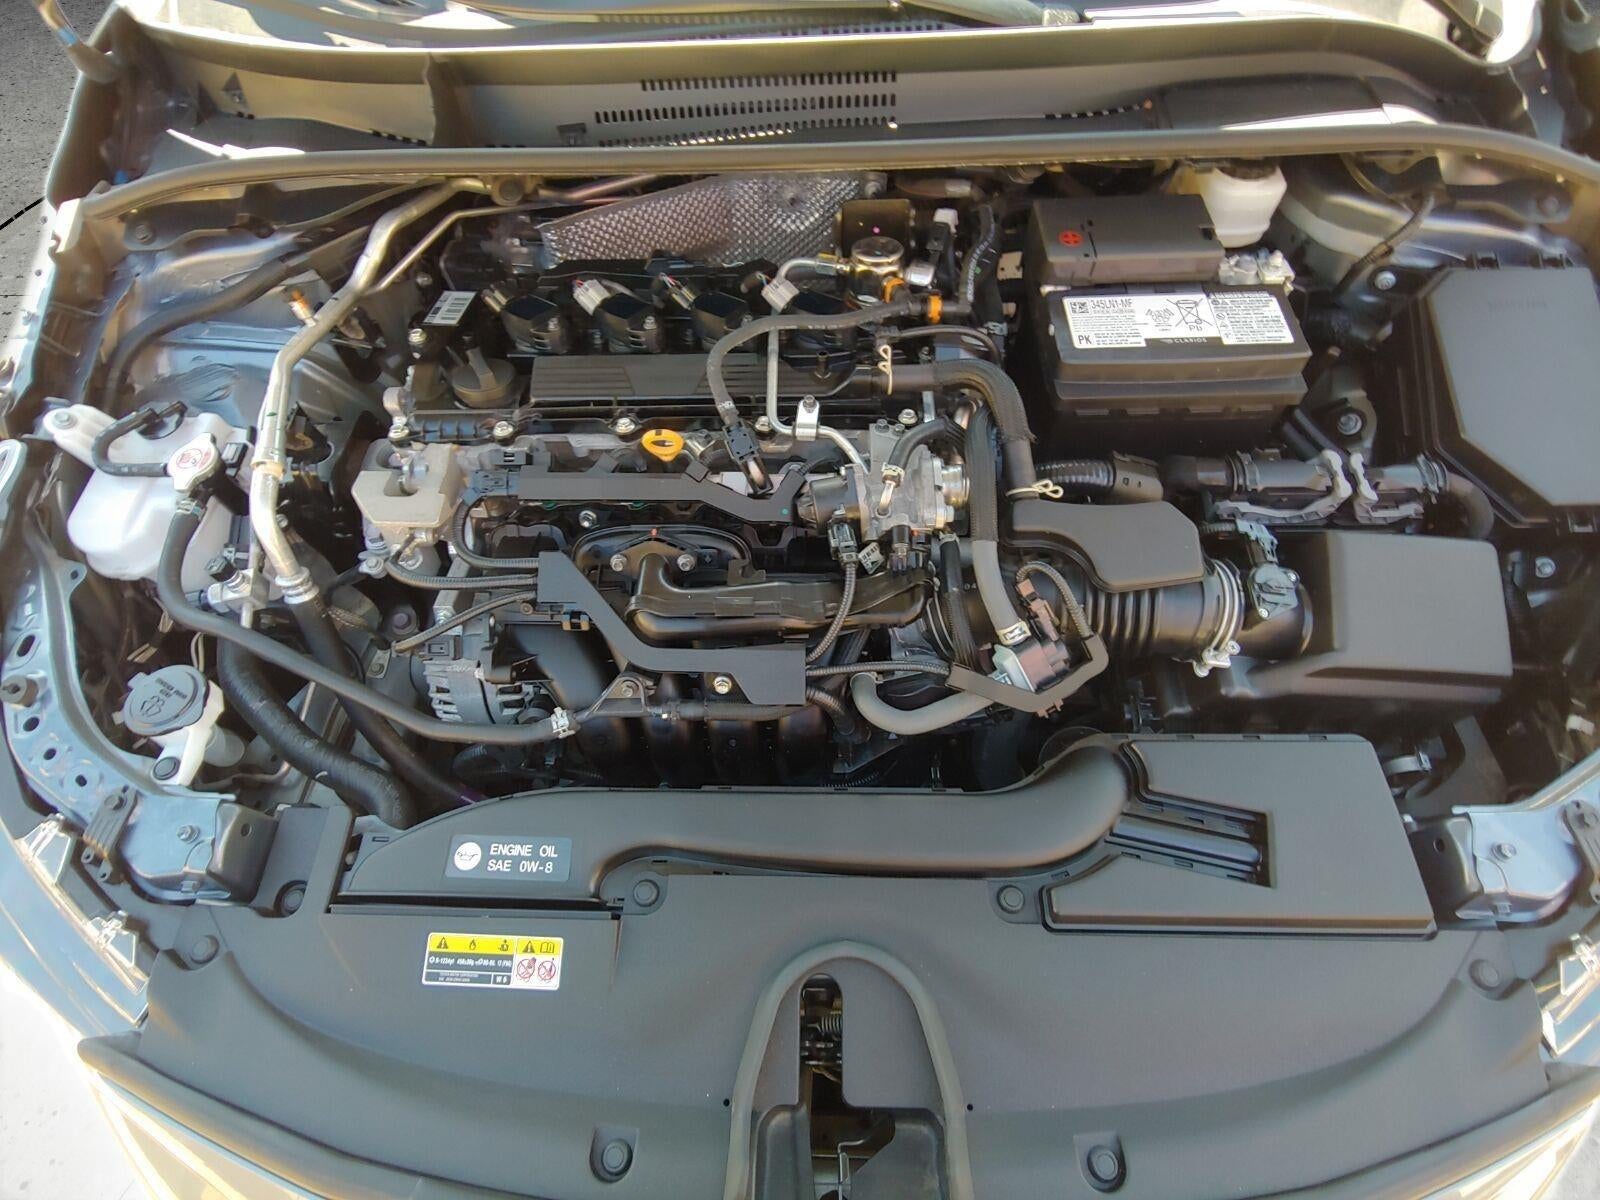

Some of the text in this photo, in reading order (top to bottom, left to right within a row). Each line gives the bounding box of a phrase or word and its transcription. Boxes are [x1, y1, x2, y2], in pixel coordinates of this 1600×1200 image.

[1077, 334, 1092, 345] PK
[489, 843, 558, 858] ENGINE OIL
[487, 859, 553, 874] SAE 0W-8
